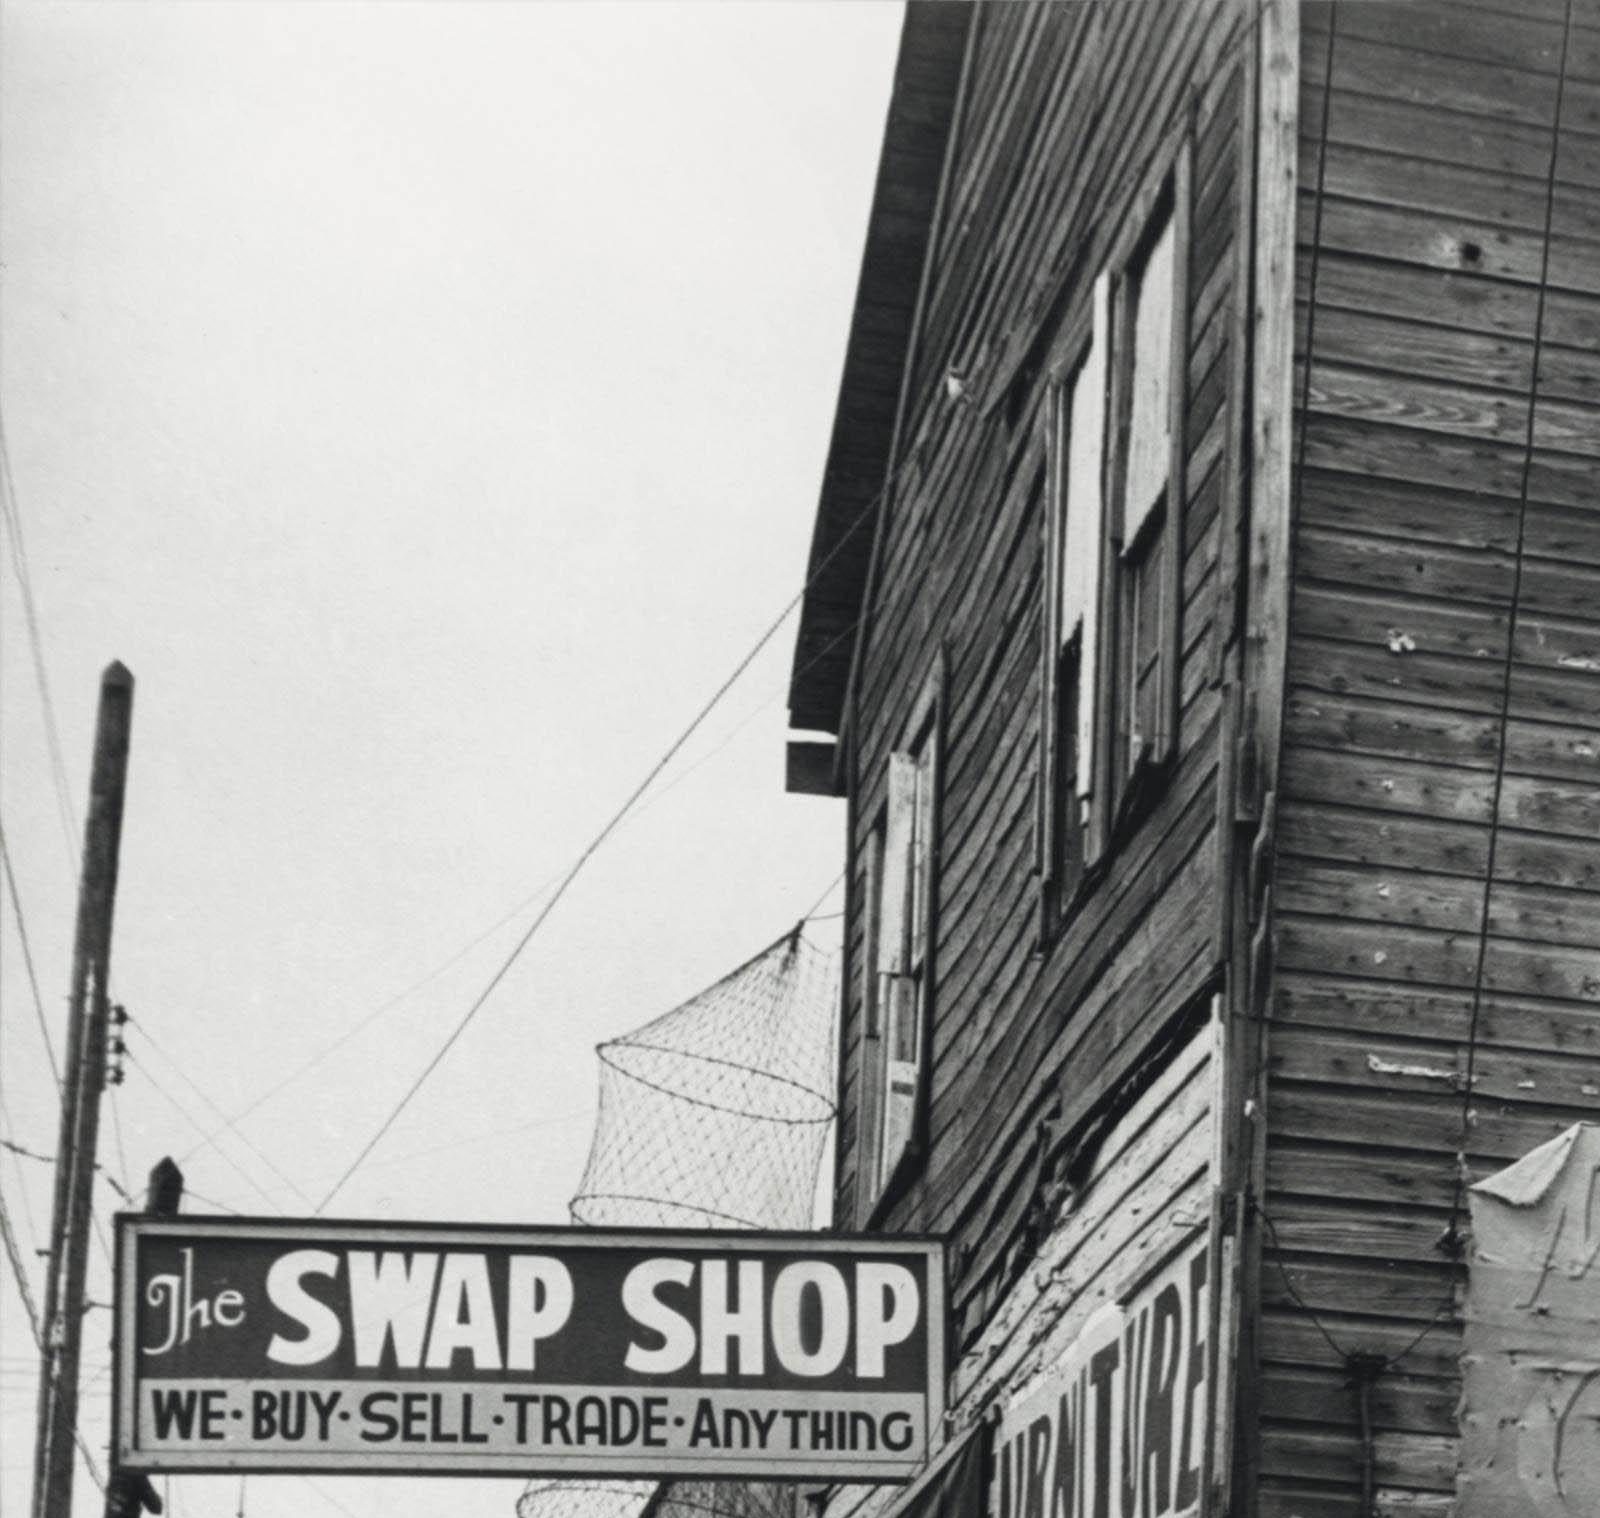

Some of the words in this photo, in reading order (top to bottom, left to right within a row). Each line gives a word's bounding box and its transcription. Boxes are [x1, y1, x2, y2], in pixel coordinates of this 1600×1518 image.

[143, 1247, 246, 1354] The
[266, 1248, 575, 1371] SWAP
[621, 1257, 920, 1378] SHOP
[150, 1387, 229, 1441] WE
[252, 1389, 342, 1442] BUY
[358, 1392, 493, 1446] SELL
[503, 1395, 670, 1448] TRADE
